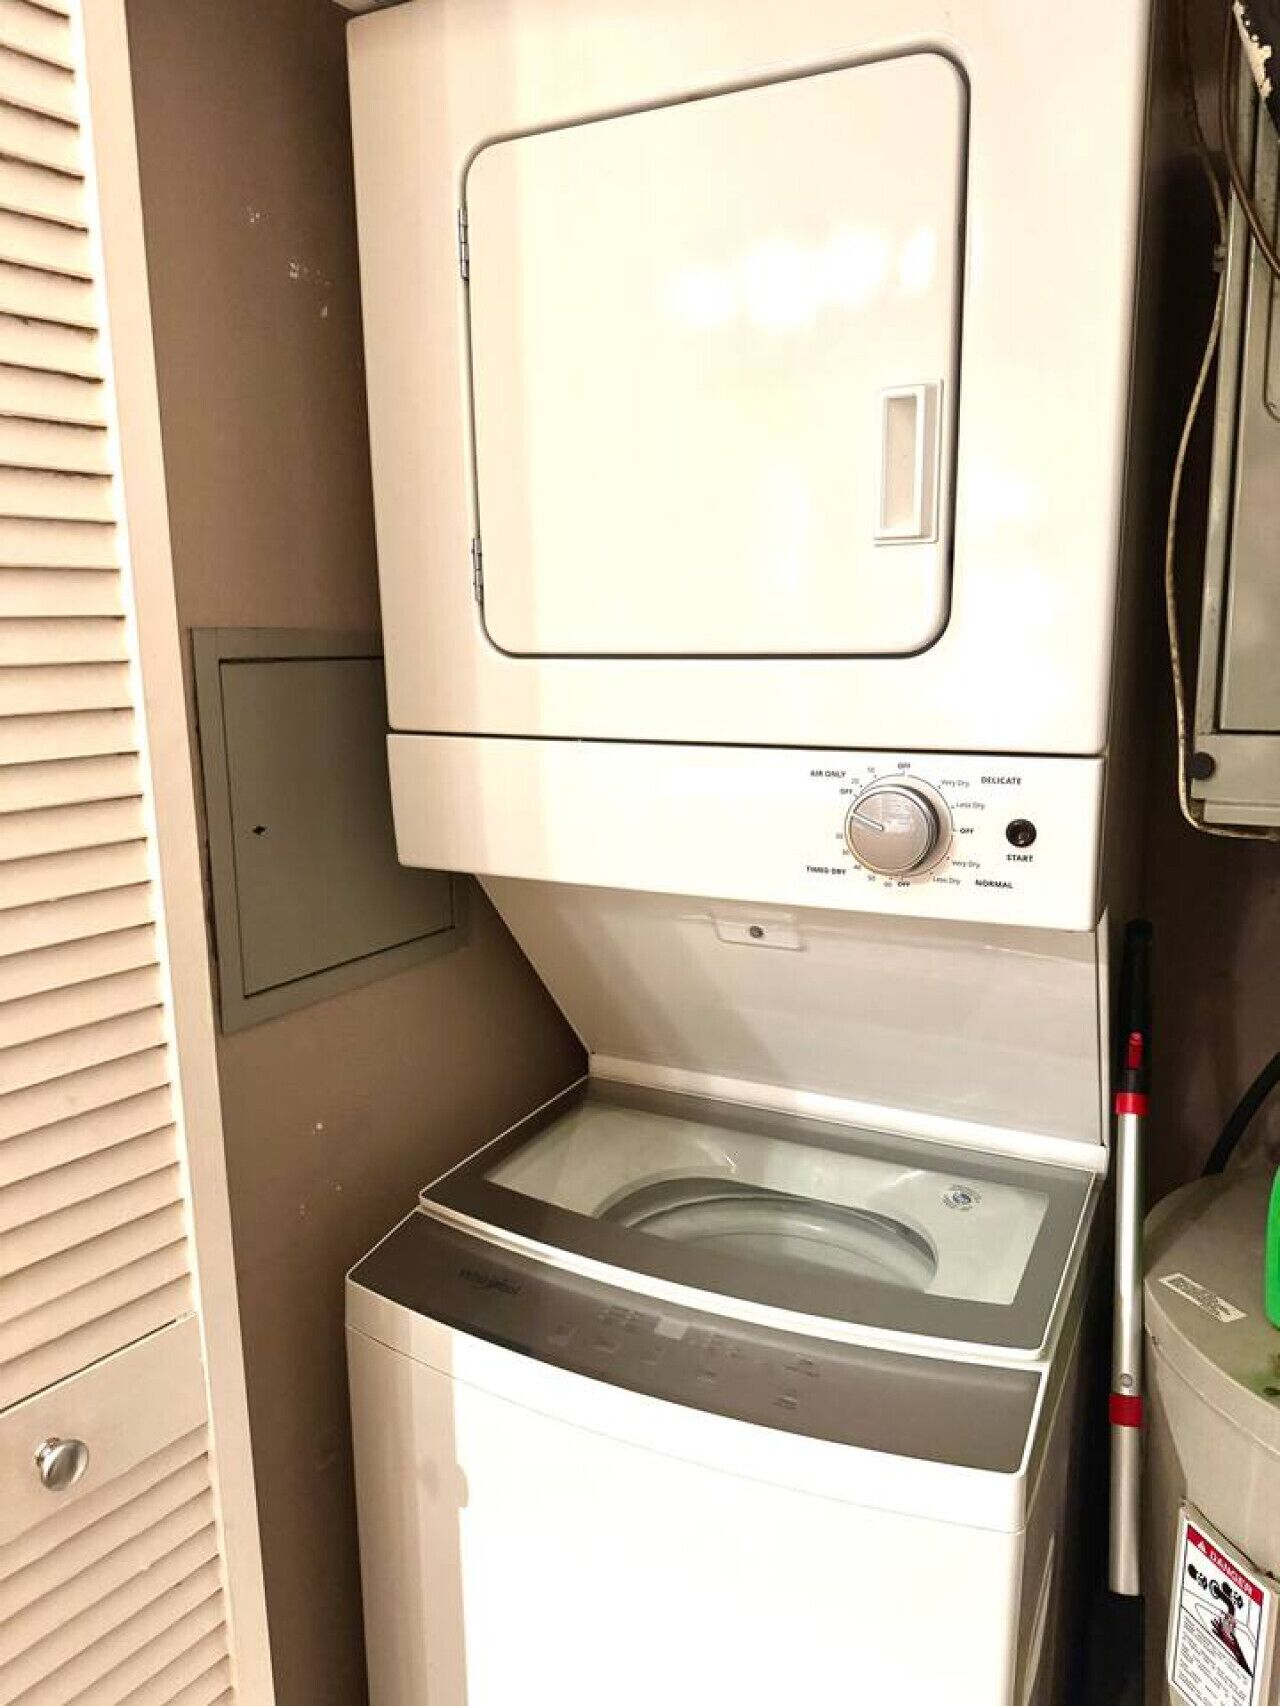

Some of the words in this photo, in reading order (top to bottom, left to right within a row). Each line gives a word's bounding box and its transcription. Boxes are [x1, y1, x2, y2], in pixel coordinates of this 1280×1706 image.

[810, 769, 824, 778] AIR
[824, 770, 847, 779] ONLY
[980, 776, 1023, 785] DELICATE
[959, 827, 975, 835] OFF
[1005, 854, 1034, 863] START
[831, 867, 847, 875] DRY
[975, 879, 1013, 890] NORMAL
[1209, 1550, 1253, 1596] DANGER
